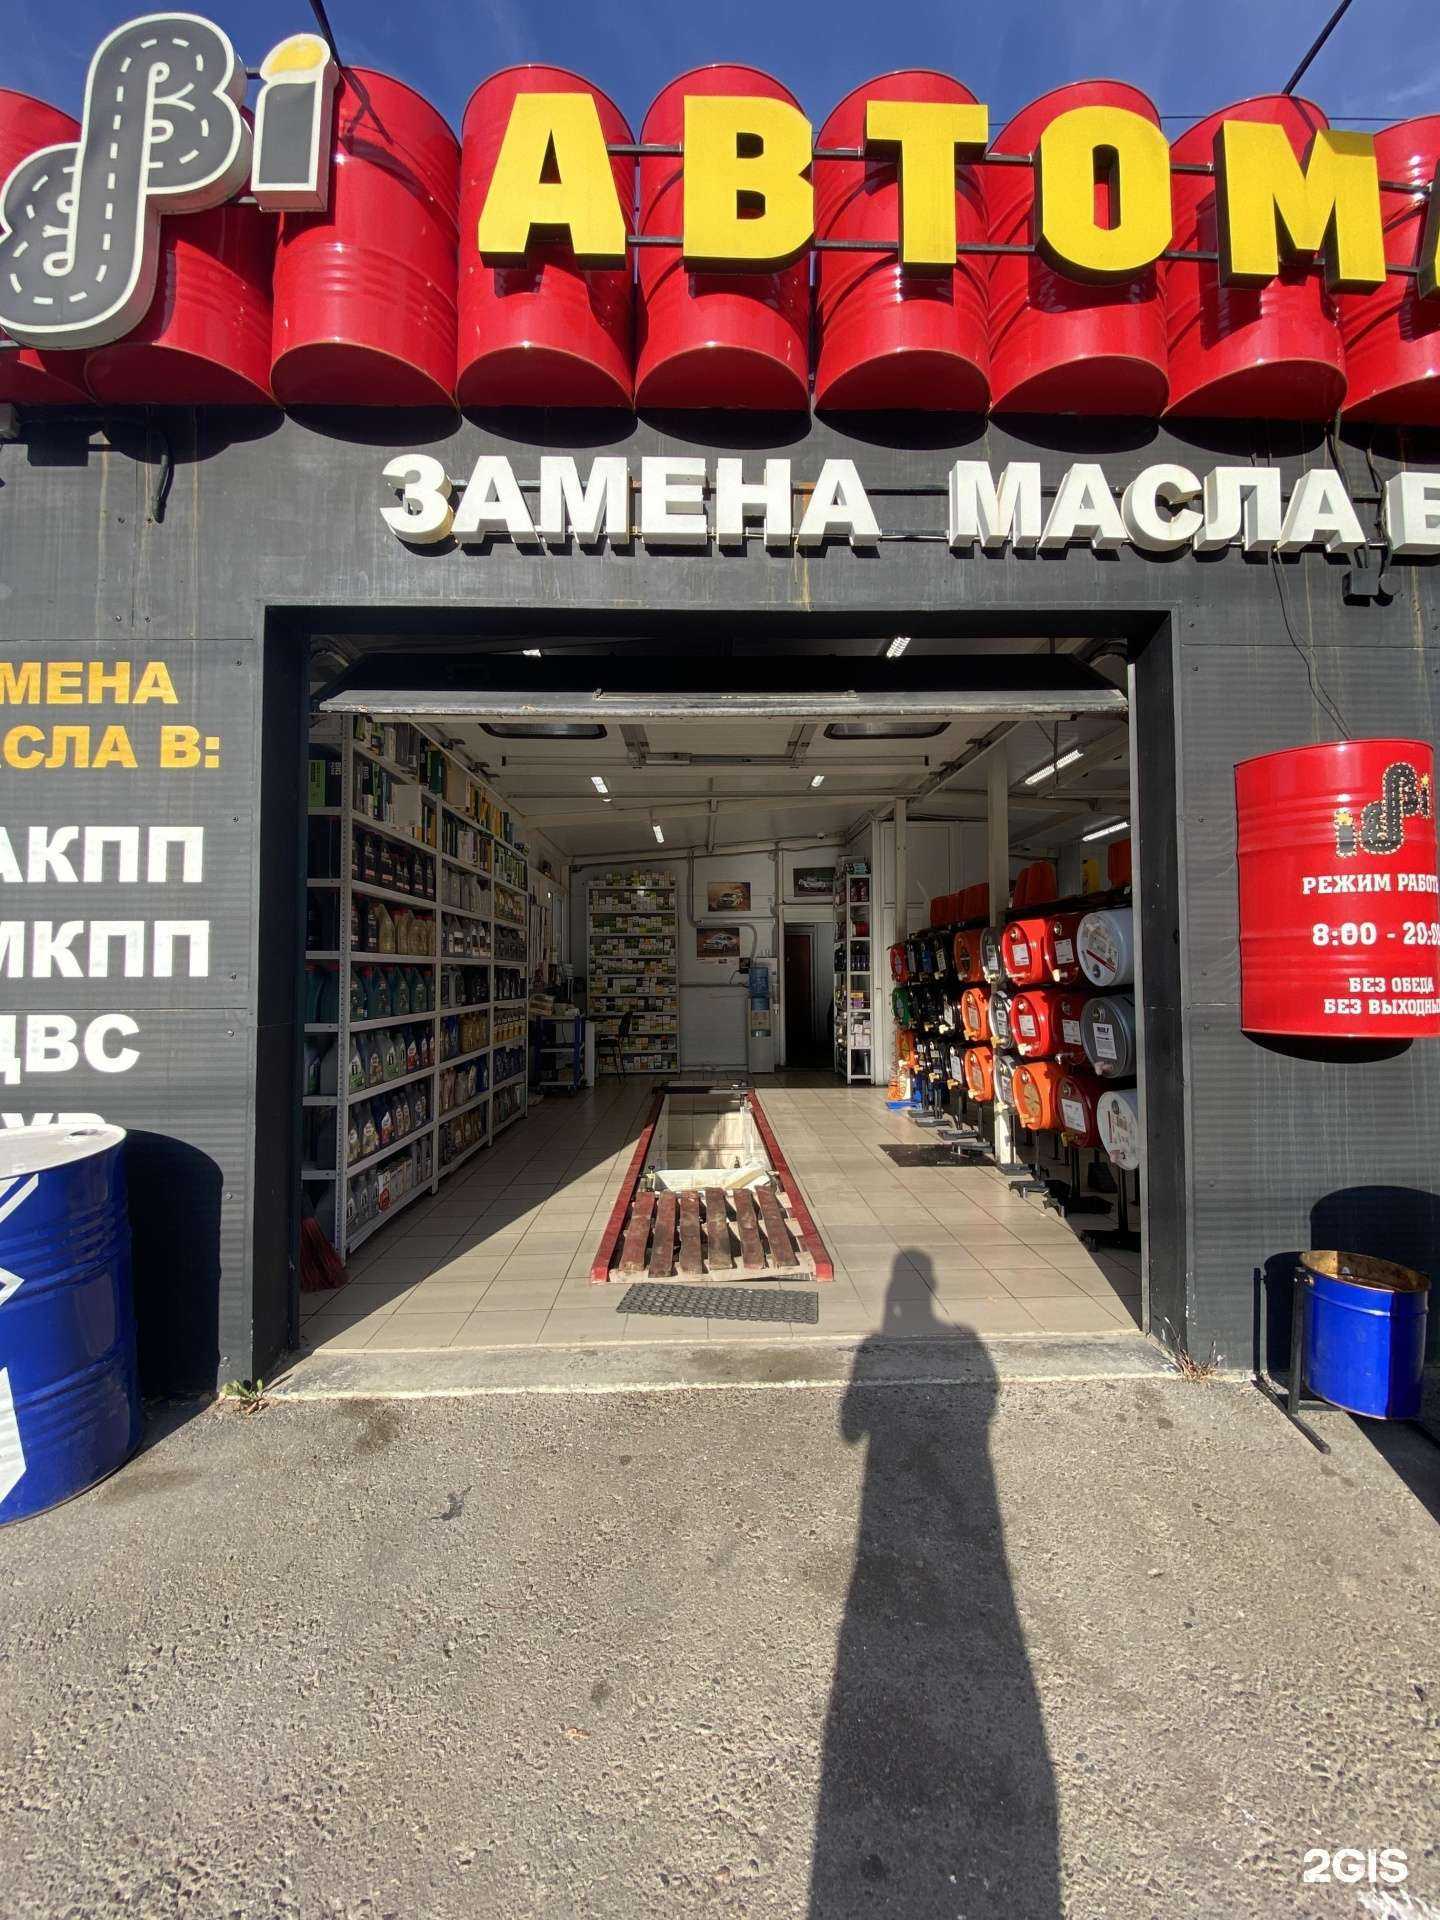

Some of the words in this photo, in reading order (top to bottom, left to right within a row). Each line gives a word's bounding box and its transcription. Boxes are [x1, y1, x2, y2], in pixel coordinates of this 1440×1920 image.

[477, 92, 1440, 288] АВТОМ
[379, 454, 881, 548] ЗАМЕНА
[948, 461, 1367, 553] МАСЛА
[0, 725, 138, 769] СЛА
[160, 725, 220, 769] В:
[1302, 873, 1392, 895] РЕЖИМ
[1397, 873, 1439, 893] РАБОТ
[1312, 922, 1377, 946] 8:00
[1349, 977, 1386, 993] БЕЗ
[1391, 977, 1434, 994] ОБЕДА
[1323, 998, 1362, 1015] БЕЗ
